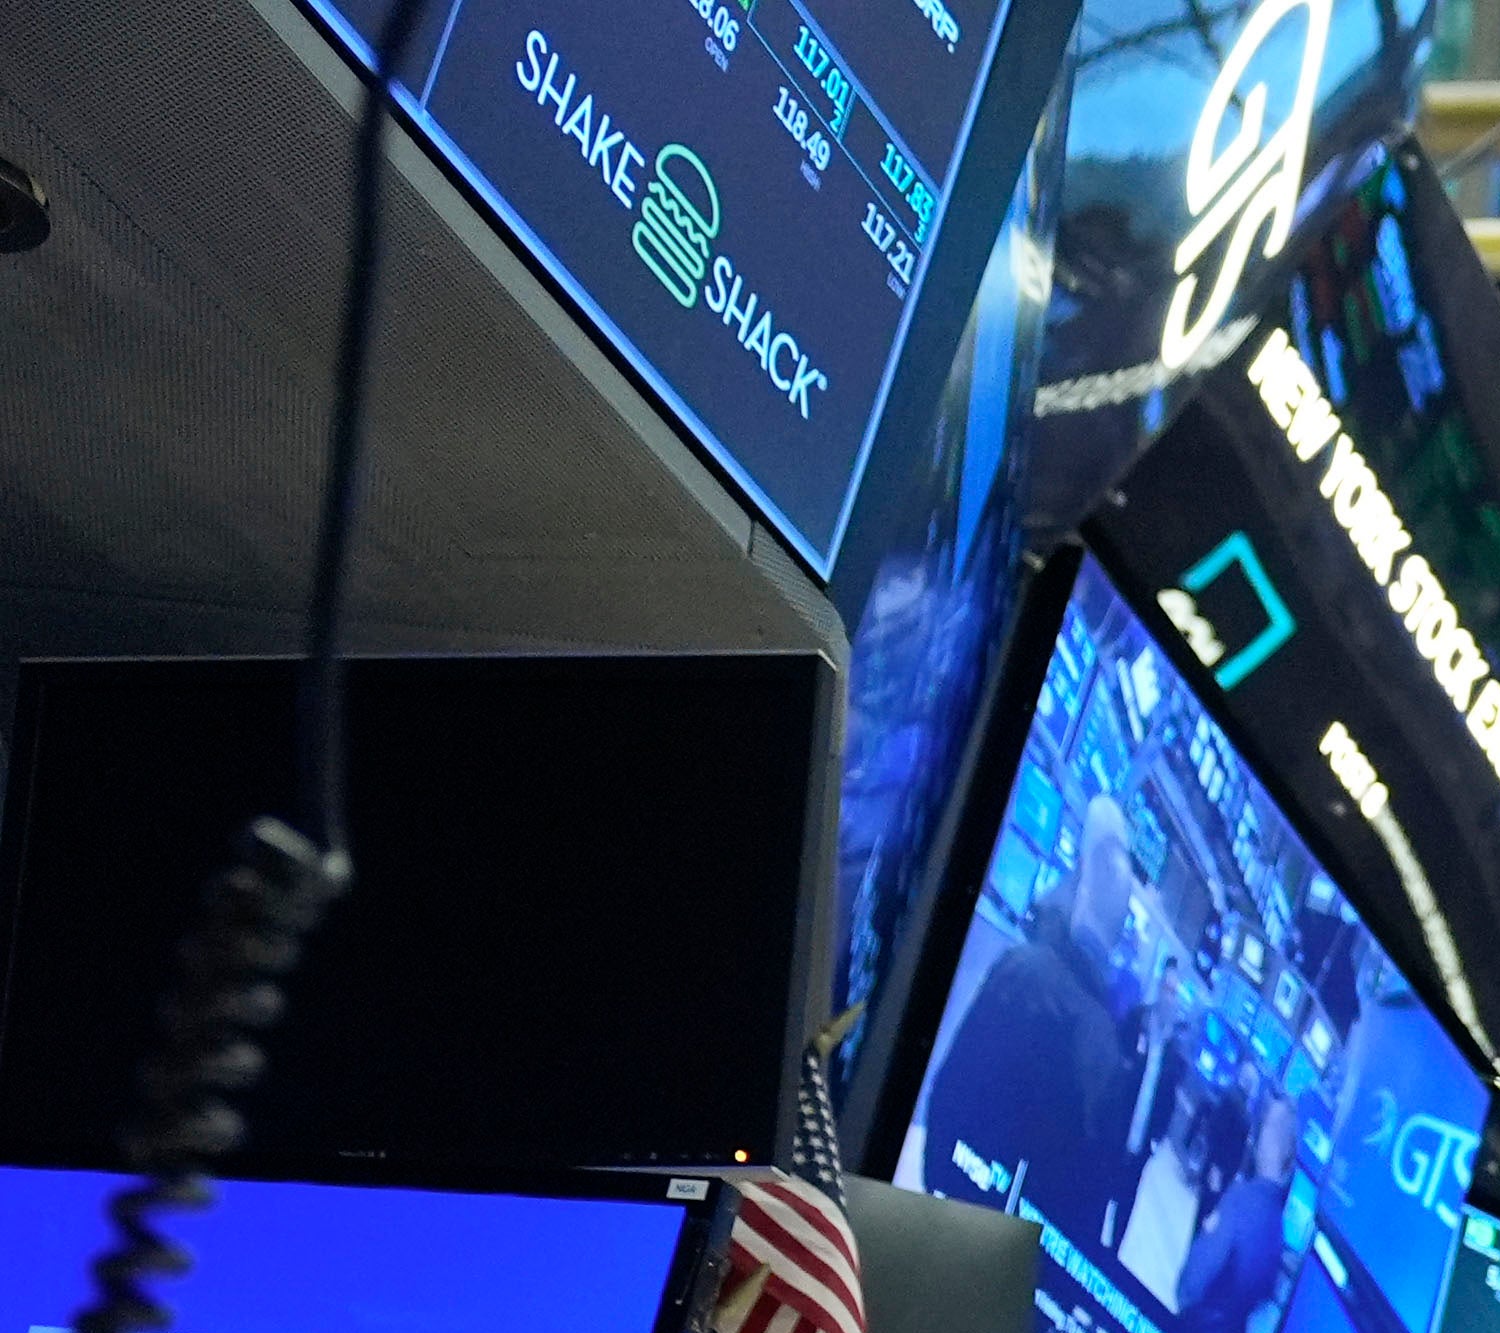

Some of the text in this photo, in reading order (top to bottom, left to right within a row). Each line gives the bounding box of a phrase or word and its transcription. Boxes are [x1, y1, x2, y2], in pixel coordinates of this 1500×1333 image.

[689, 0, 740, 51] 8.06
[793, 26, 849, 113] 117.01
[516, 30, 645, 210] SHAKE
[773, 86, 831, 171] 118.49
[861, 202, 915, 285] 117.21
[704, 256, 822, 420] SHACK
[1249, 327, 1342, 463] NEW
[1320, 432, 1412, 586] YORK
[1390, 554, 1489, 712] STOCK
